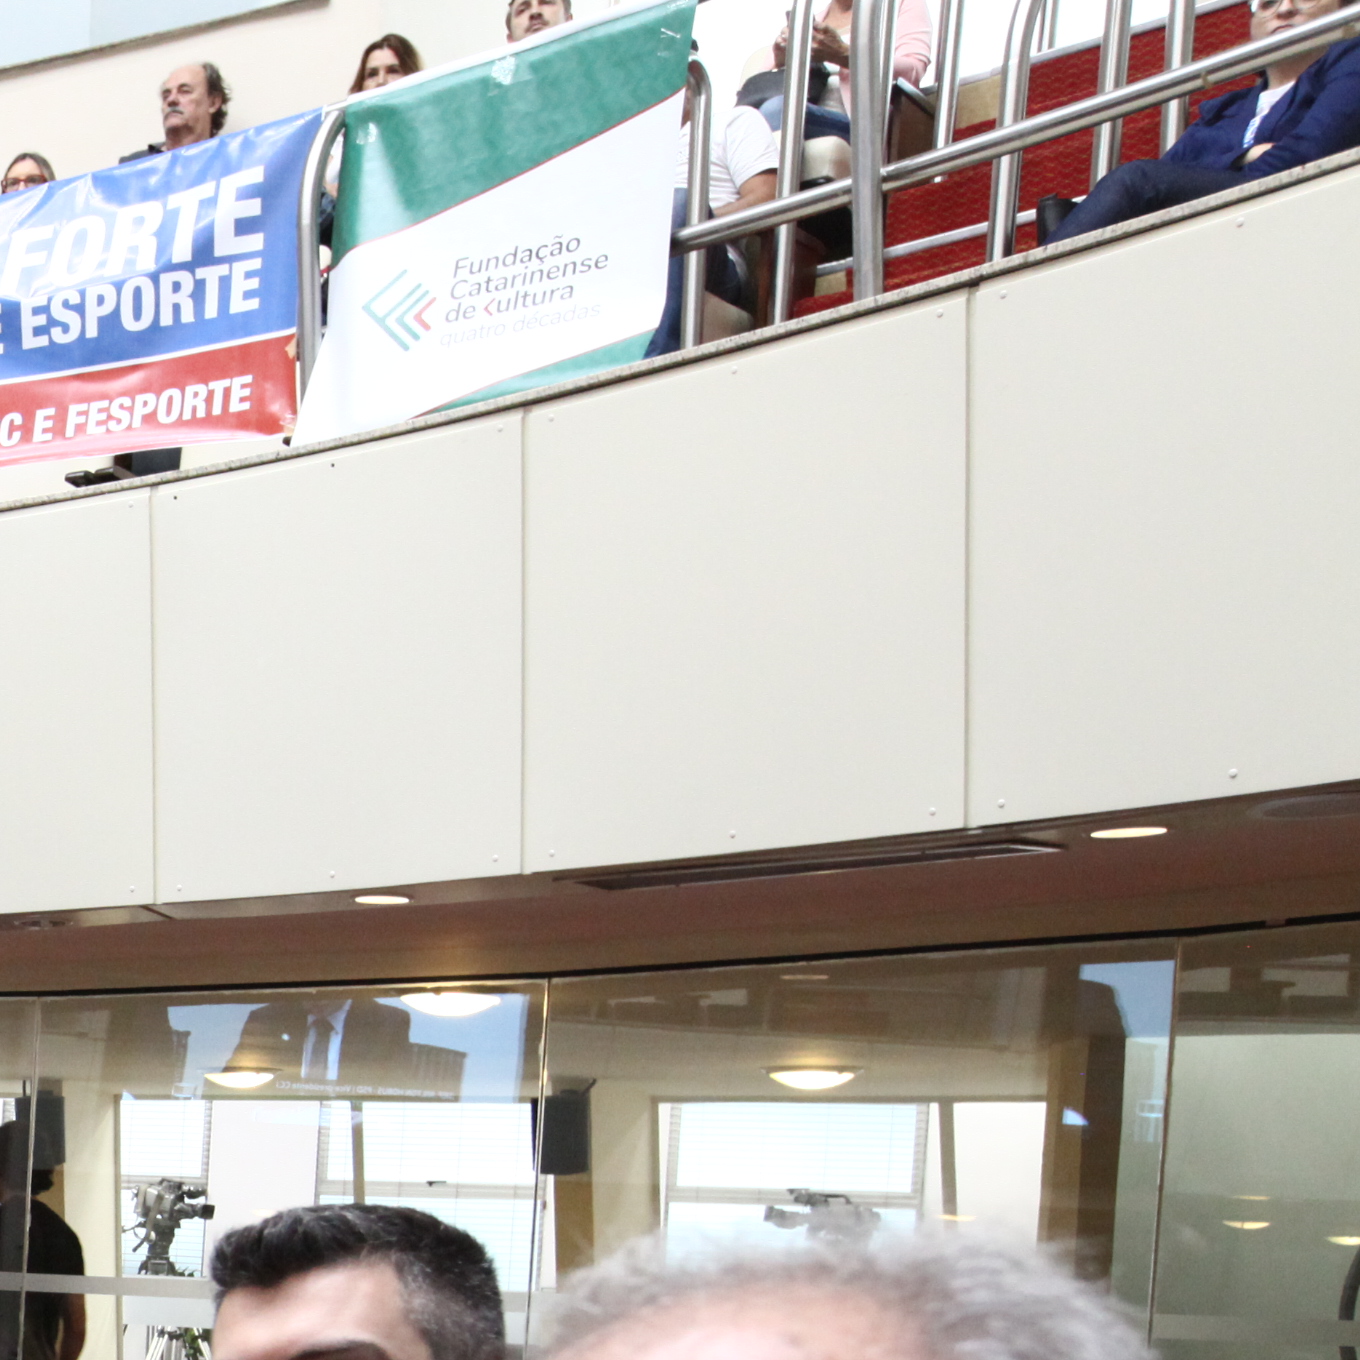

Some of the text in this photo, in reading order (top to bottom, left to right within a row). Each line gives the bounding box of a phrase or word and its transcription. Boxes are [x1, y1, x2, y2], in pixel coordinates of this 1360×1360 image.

[450, 253, 609, 301] Catarinense
[452, 235, 581, 279] Fundação
[20, 257, 262, 350] ESPORTE
[439, 302, 601, 347] quatro décadas
[444, 304, 476, 324] de
[32, 408, 56, 443] E
[65, 375, 253, 439] FESPORTE
